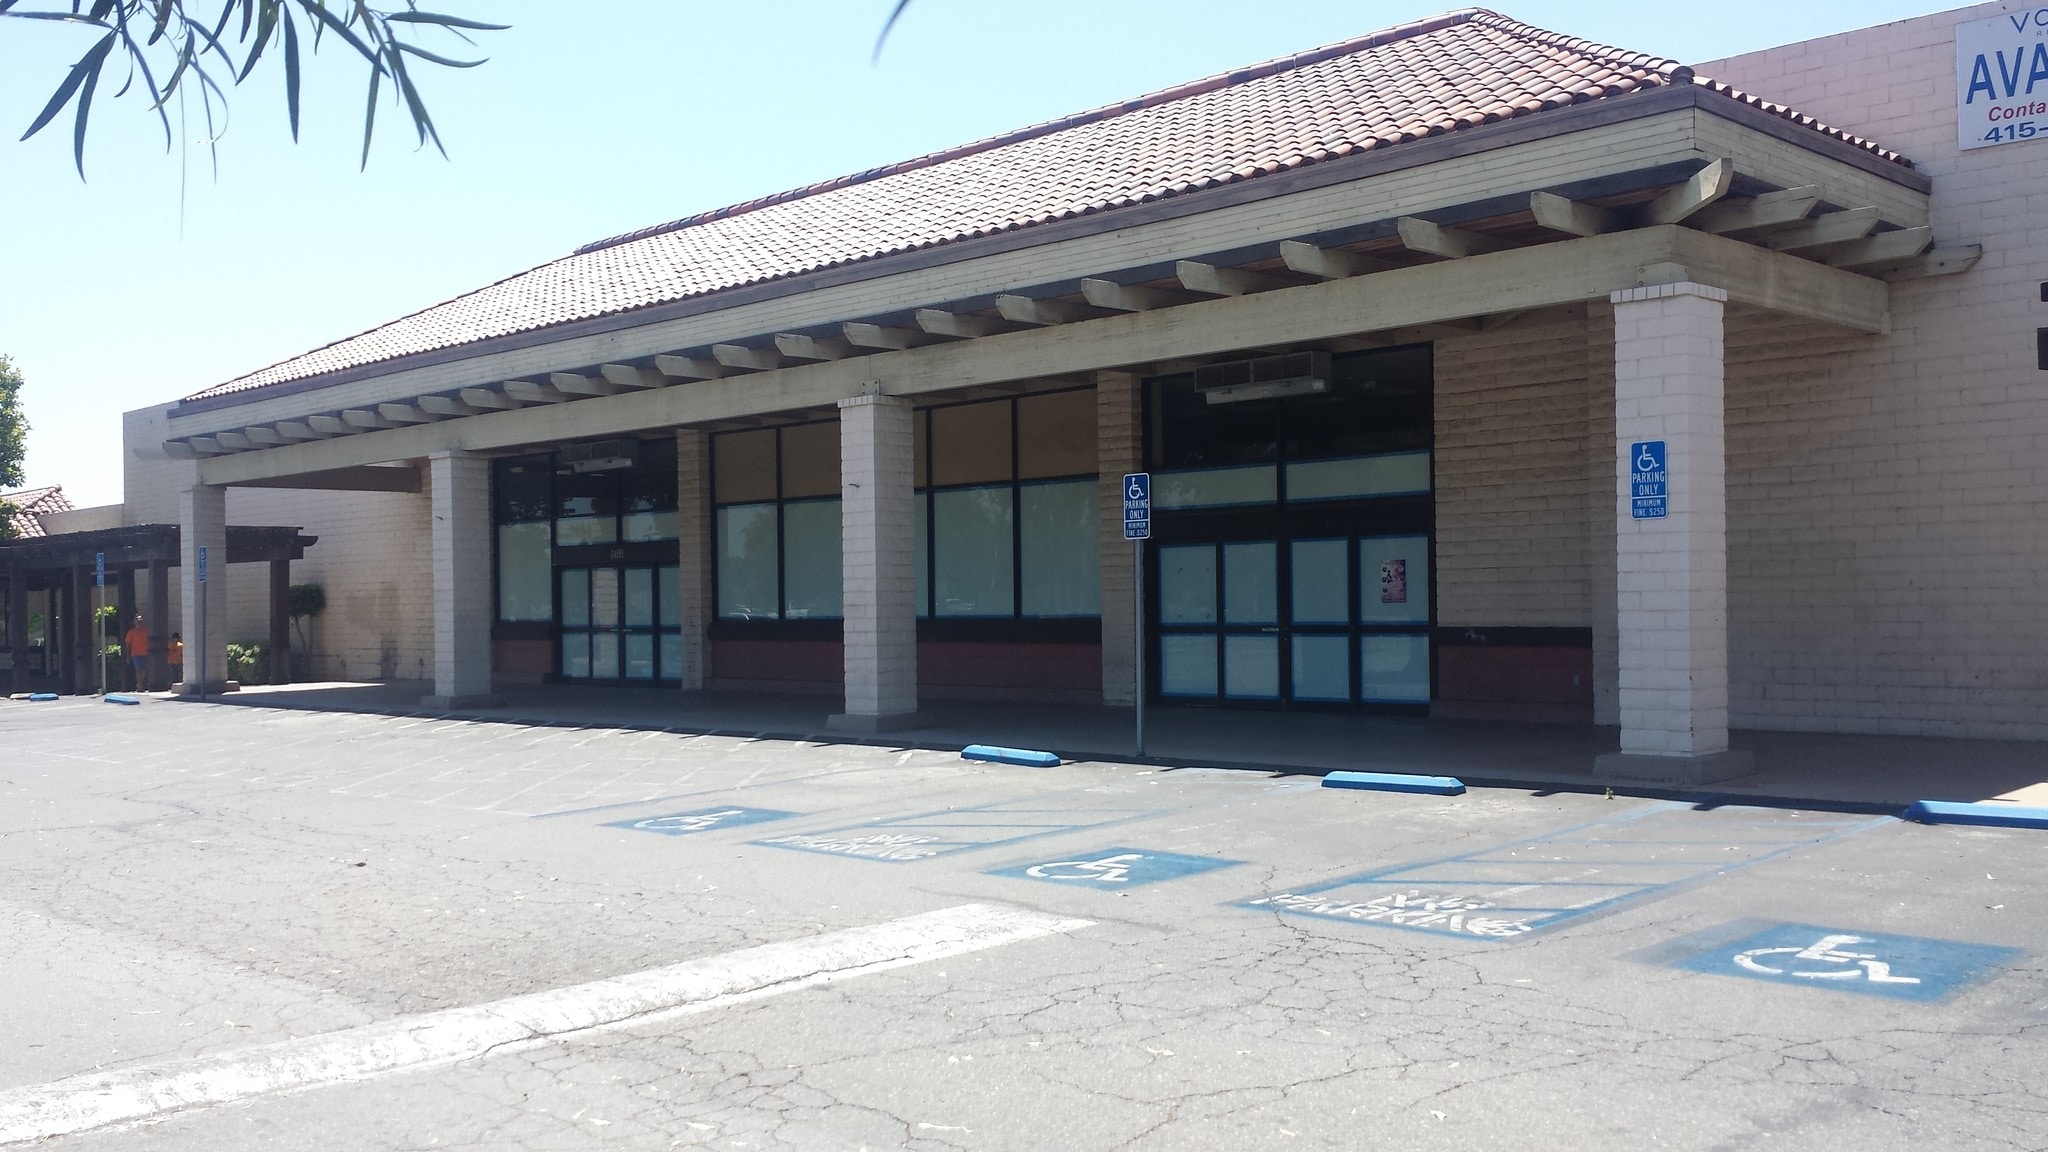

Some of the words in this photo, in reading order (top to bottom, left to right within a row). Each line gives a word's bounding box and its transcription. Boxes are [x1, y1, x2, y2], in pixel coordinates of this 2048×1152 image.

[1966, 43, 2048, 104] AVA
[1988, 101, 2046, 121] Conta
[1632, 471, 1665, 484] PARKING
[1639, 484, 1659, 496] ONLY
[1125, 499, 1148, 510] PARKING
[1637, 498, 1661, 507] MINIMUM
[1129, 509, 1145, 519] ONLY
[1634, 508, 1647, 517] FINE
[1648, 507, 1665, 516] $250
